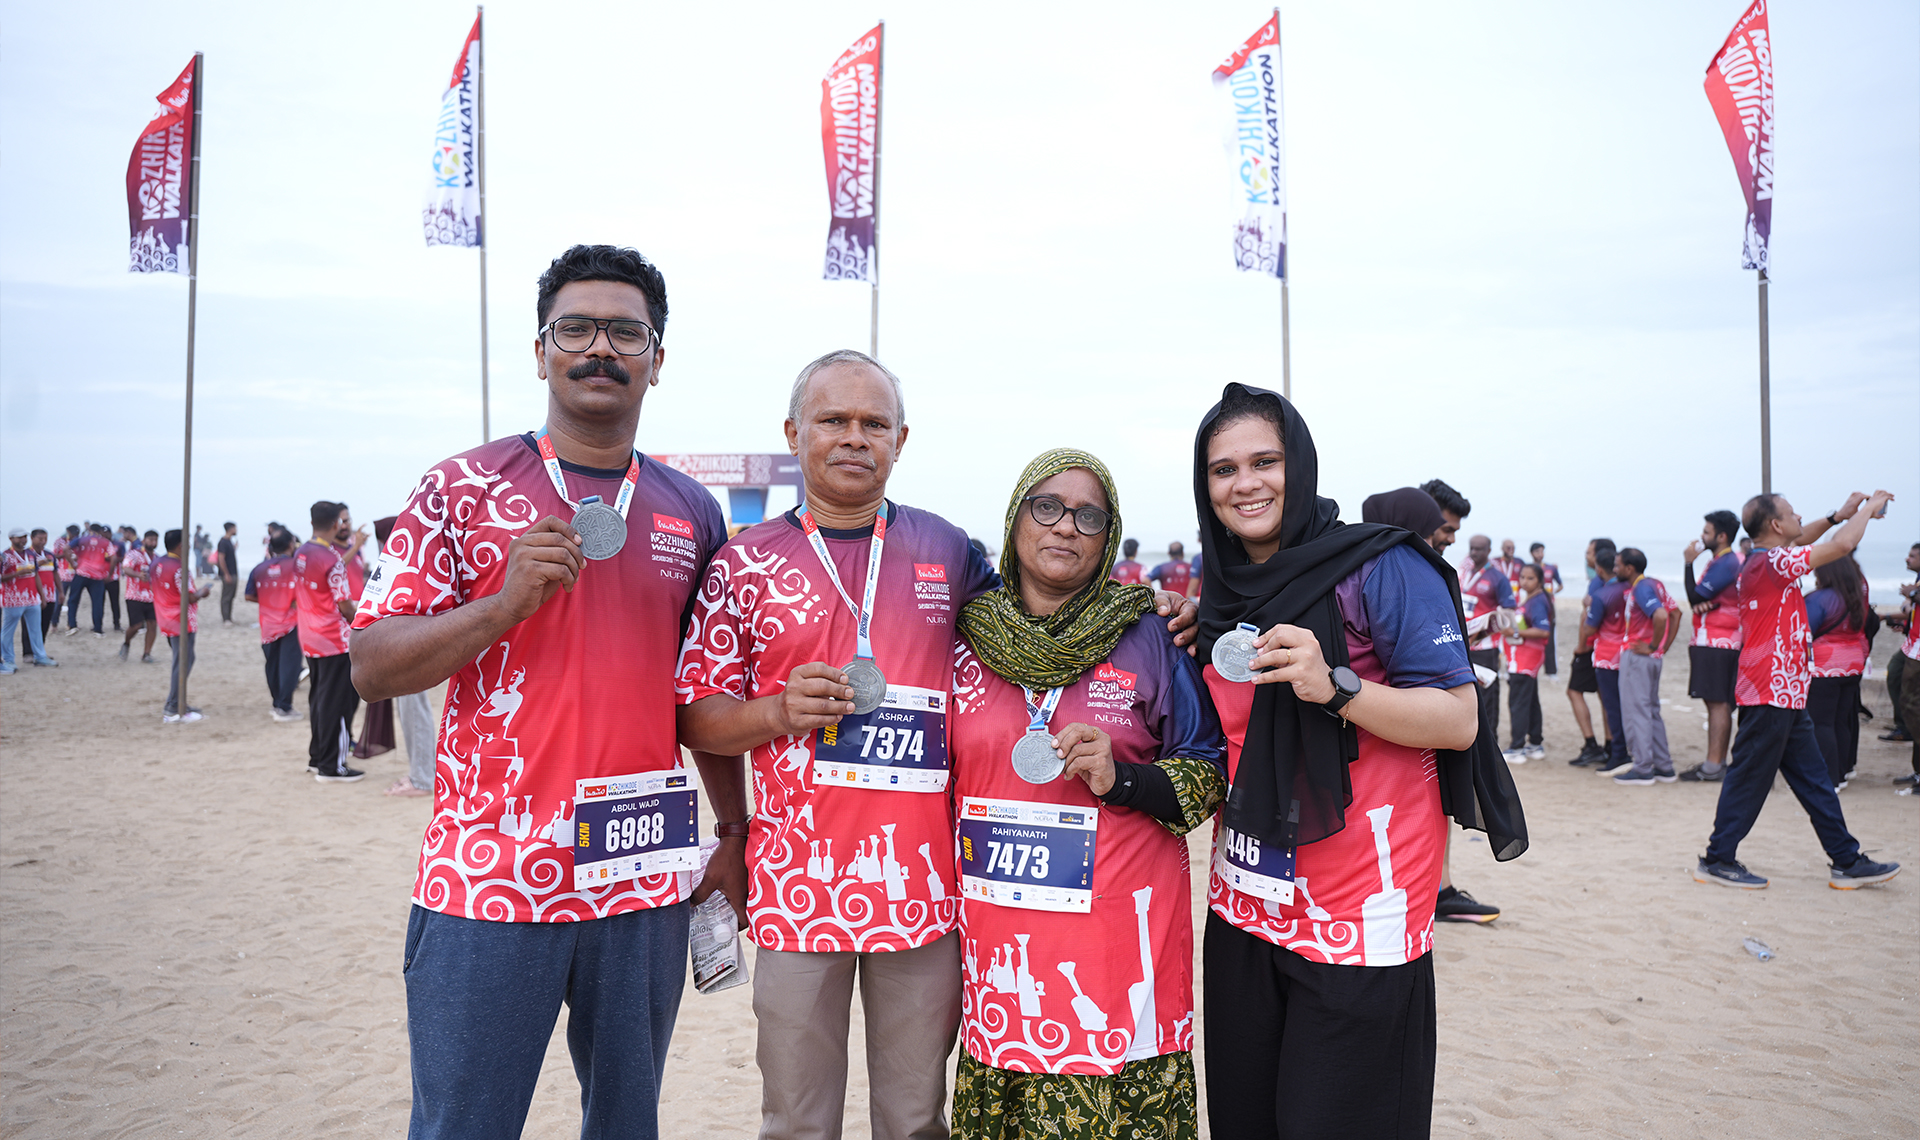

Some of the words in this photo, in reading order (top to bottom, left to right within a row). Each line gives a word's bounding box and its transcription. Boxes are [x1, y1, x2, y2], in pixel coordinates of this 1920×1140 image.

[459, 59, 474, 188] WALKATHO
[1748, 28, 1774, 201] WALKATHON
[828, 66, 859, 218] KOZHIKODE
[856, 63, 877, 218] WALKATHON
[1258, 54, 1280, 205] WALKATHON
[162, 119, 184, 220] WALKATH
[666, 455, 746, 473] KOZHIKODE
[650, 532, 697, 553] KOZHIKODE
[651, 543, 697, 560] WALKATHON
[660, 569, 689, 583] NURA
[926, 616, 947, 625] NURA
[878, 712, 915, 723] ASHRAF
[1095, 713, 1132, 727] NURA
[823, 722, 838, 747] 5KM
[860, 725, 924, 762] 7374
[611, 805, 637, 813] ABDUL
[639, 798, 660, 809] WAJID
[579, 822, 590, 848] 5KM
[605, 812, 665, 853] 6988
[992, 827, 1048, 840] RAHIYANATH
[962, 836, 973, 862] 5KM
[986, 840, 1050, 879] 7473
[1224, 826, 1261, 867] 446
